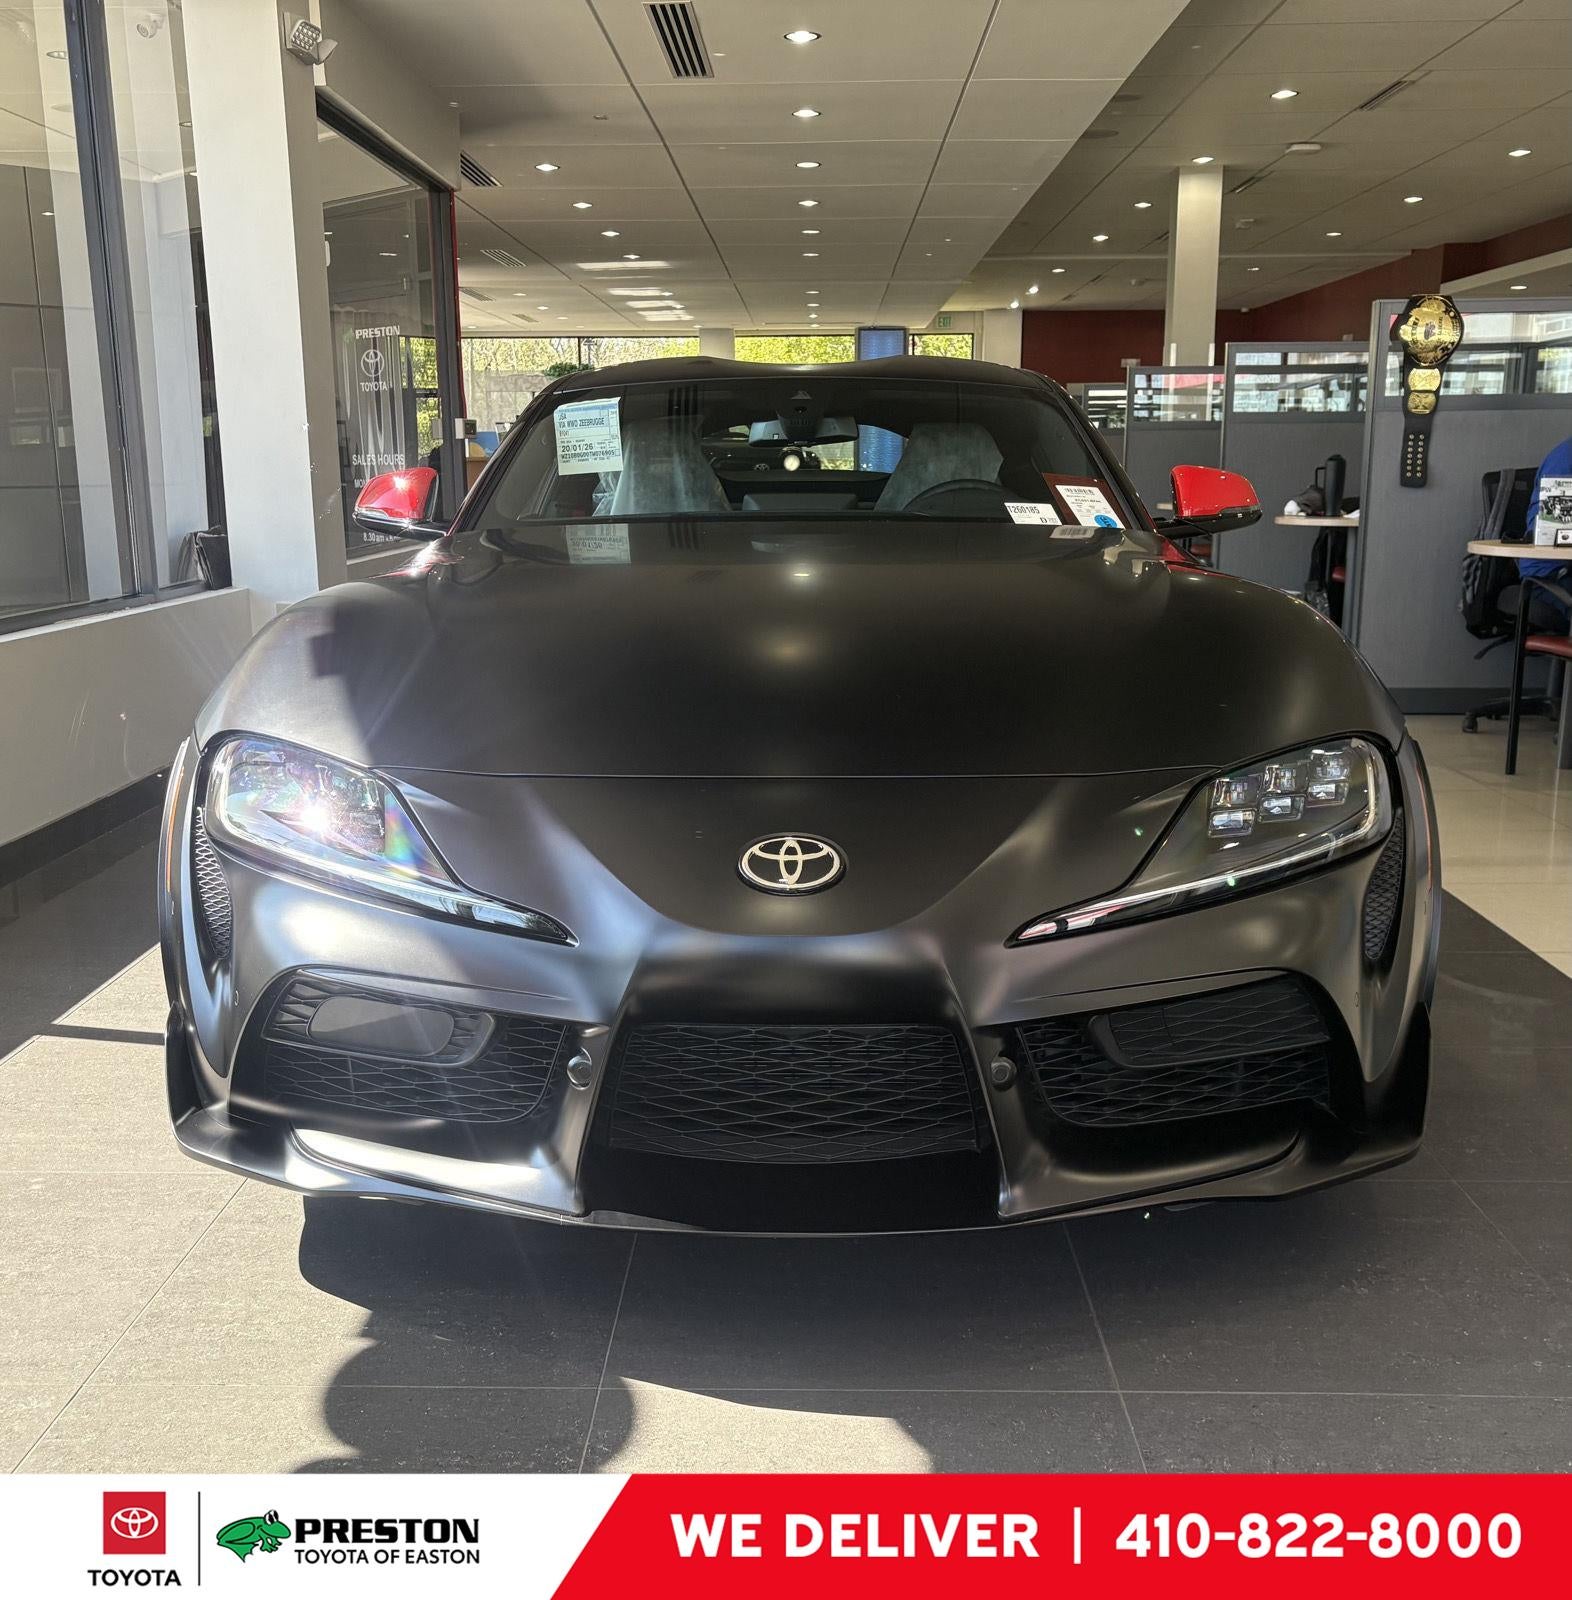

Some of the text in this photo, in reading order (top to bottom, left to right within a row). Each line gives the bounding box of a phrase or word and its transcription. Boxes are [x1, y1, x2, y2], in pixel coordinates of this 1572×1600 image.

[355, 325, 400, 339] PRESTON
[360, 381, 388, 392] TOYOTA
[579, 417, 605, 427] ZEEBRUGGE
[561, 443, 594, 453] 20/01/26
[352, 454, 405, 466] SALES HOURS
[1007, 505, 1040, 514] T260185
